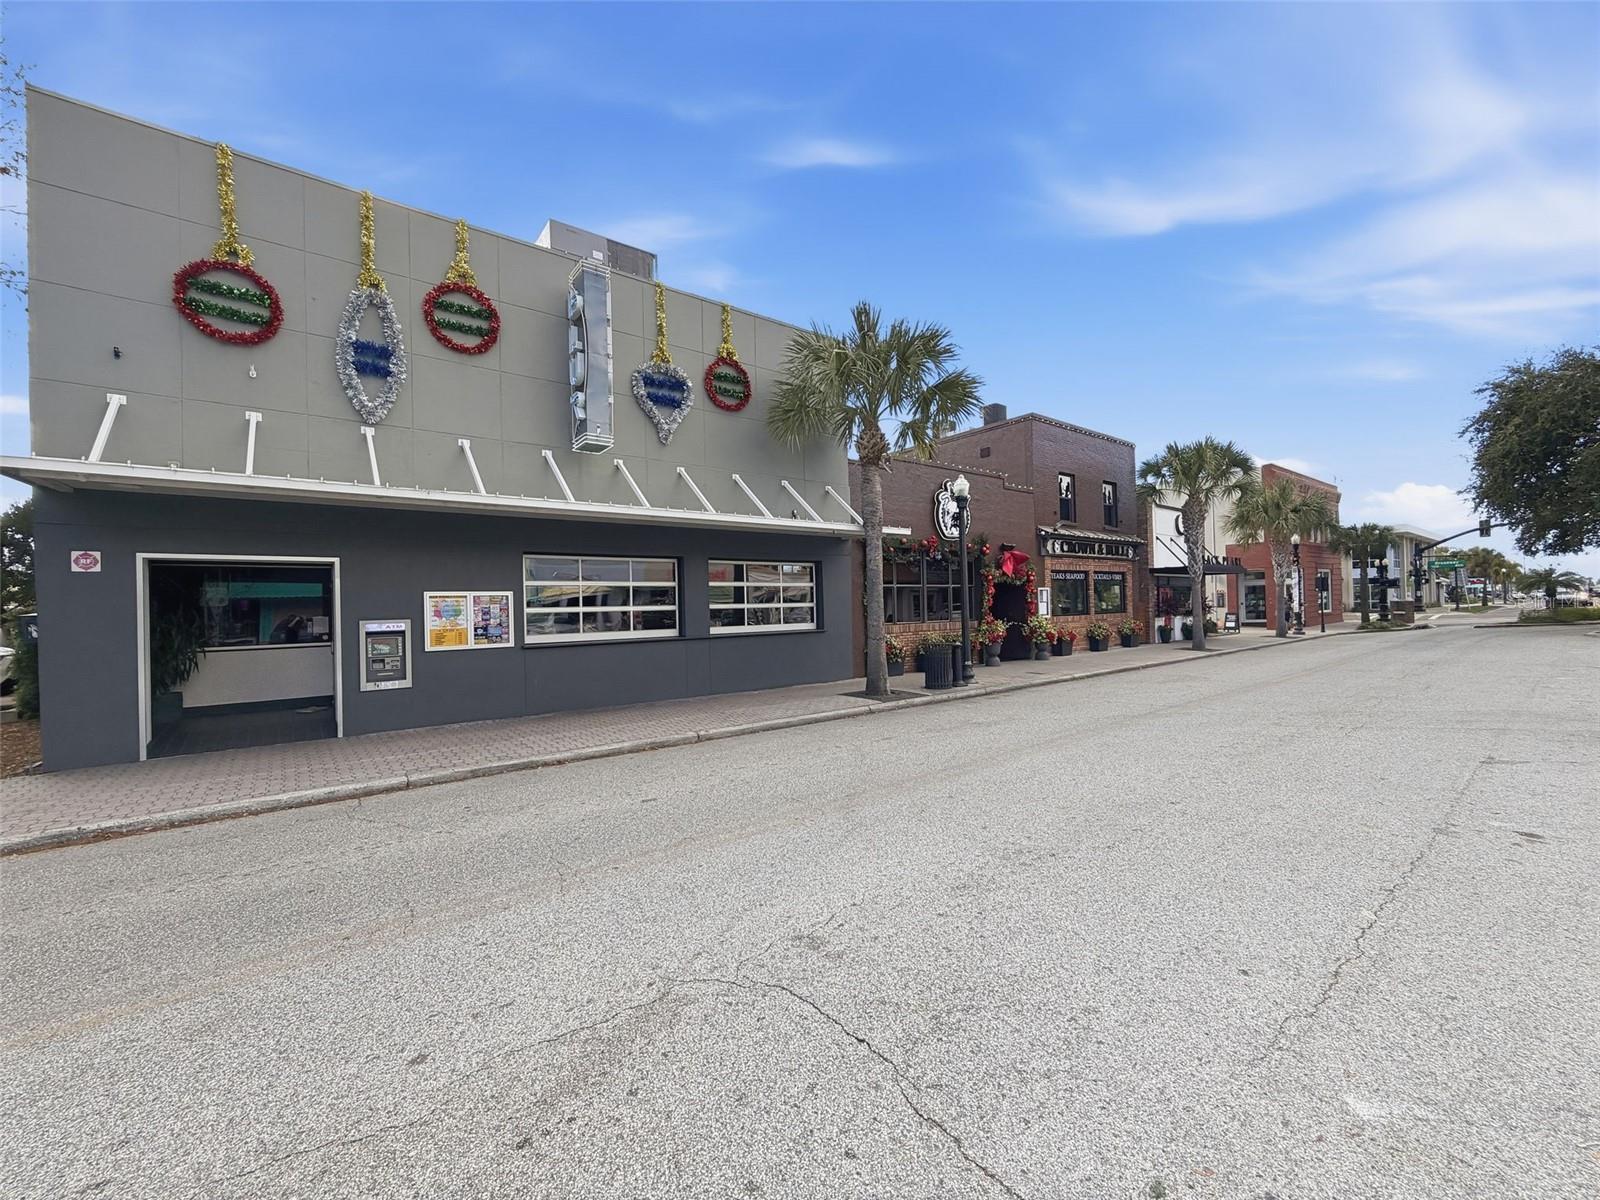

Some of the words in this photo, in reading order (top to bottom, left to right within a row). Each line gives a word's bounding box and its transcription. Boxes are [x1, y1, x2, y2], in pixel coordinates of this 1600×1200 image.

[1060, 541, 1096, 555] CROWN
[1097, 543, 1105, 555] &
[1105, 544, 1129, 557] BULL
